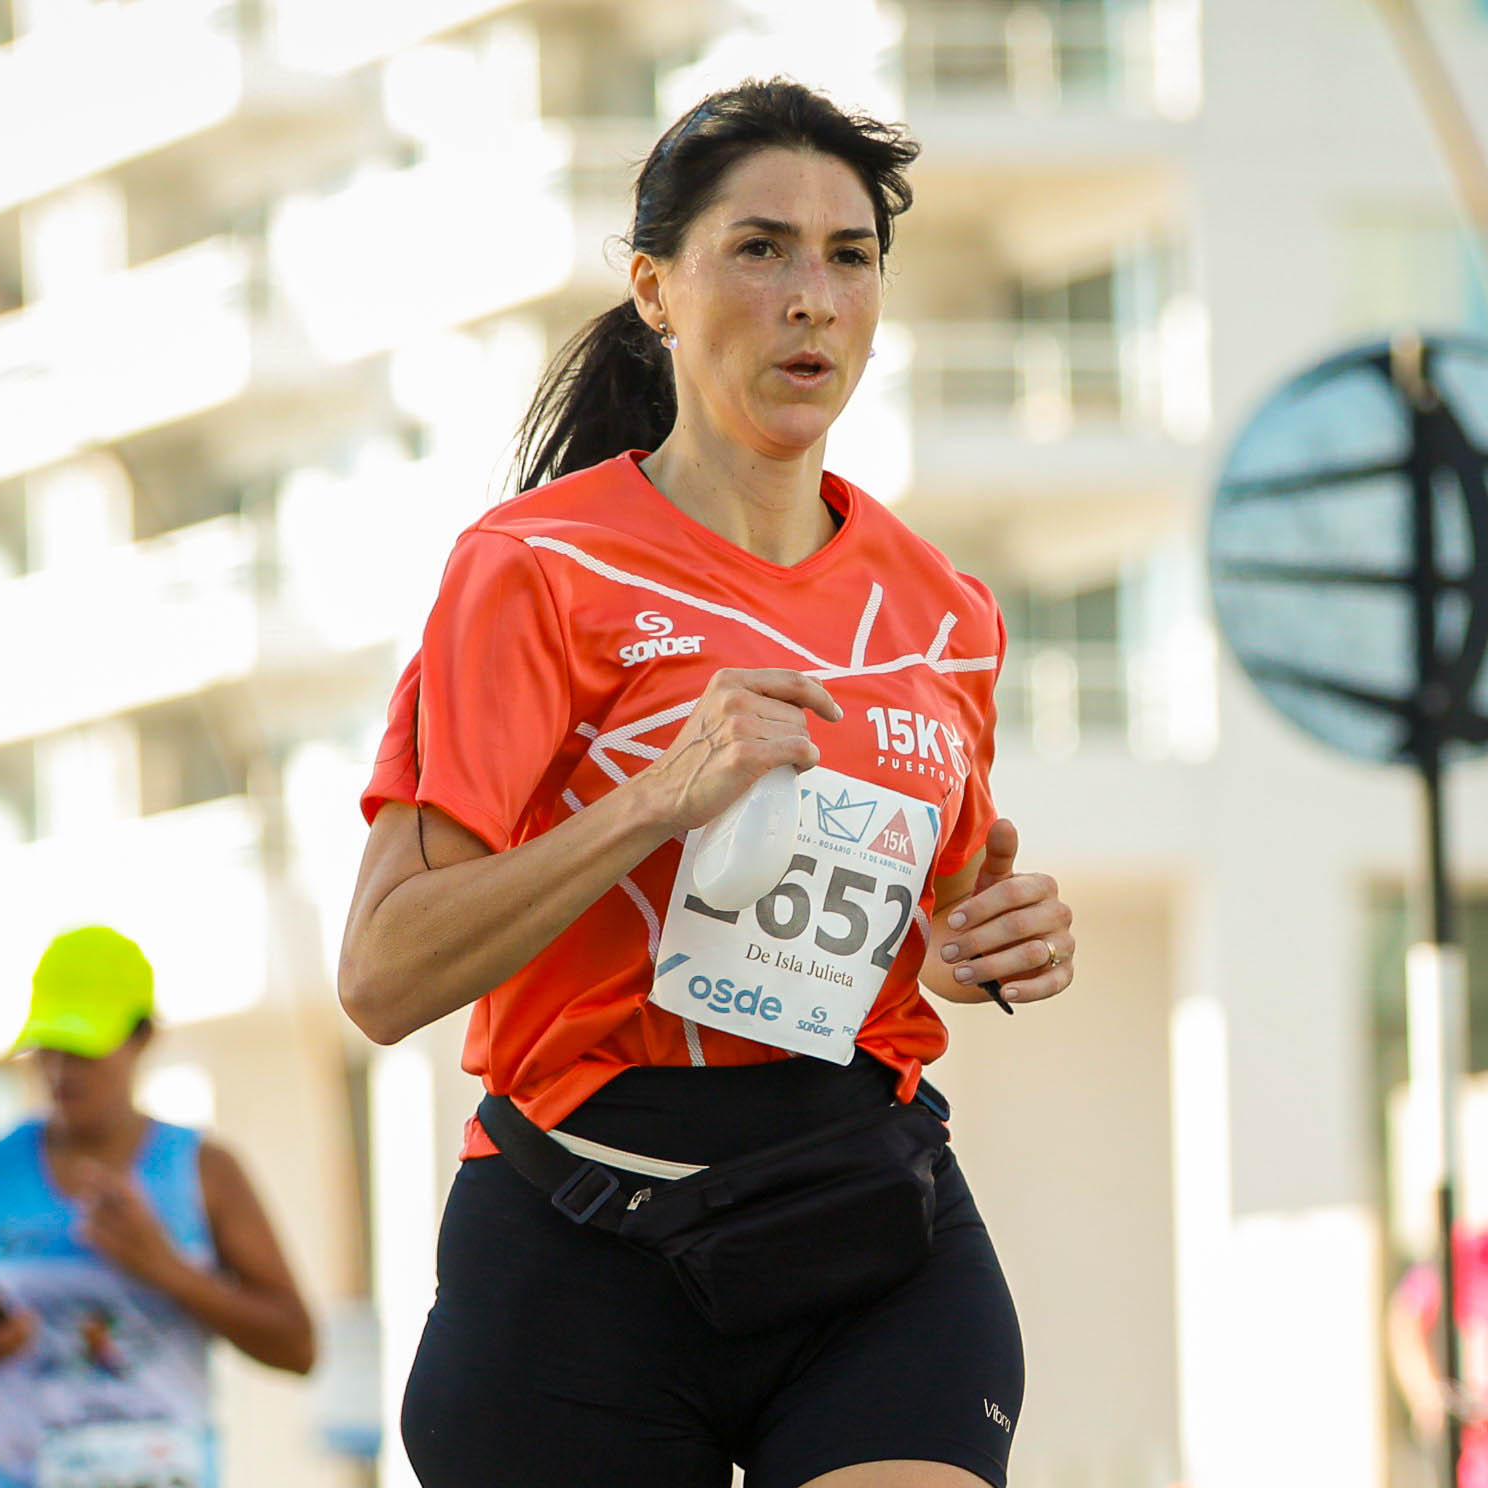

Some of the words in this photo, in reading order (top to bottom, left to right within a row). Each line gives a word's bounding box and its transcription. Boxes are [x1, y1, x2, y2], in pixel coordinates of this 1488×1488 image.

[866, 706, 945, 765] 15K
[877, 755, 945, 782] PUERTO
[819, 839, 852, 856] ROSARIO
[881, 828, 910, 856] 15K
[745, 943, 770, 964] De
[775, 950, 803, 974] Isla
[806, 960, 854, 988] Julieta
[688, 974, 783, 1022] osde
[983, 1398, 1011, 1433] Vibra
